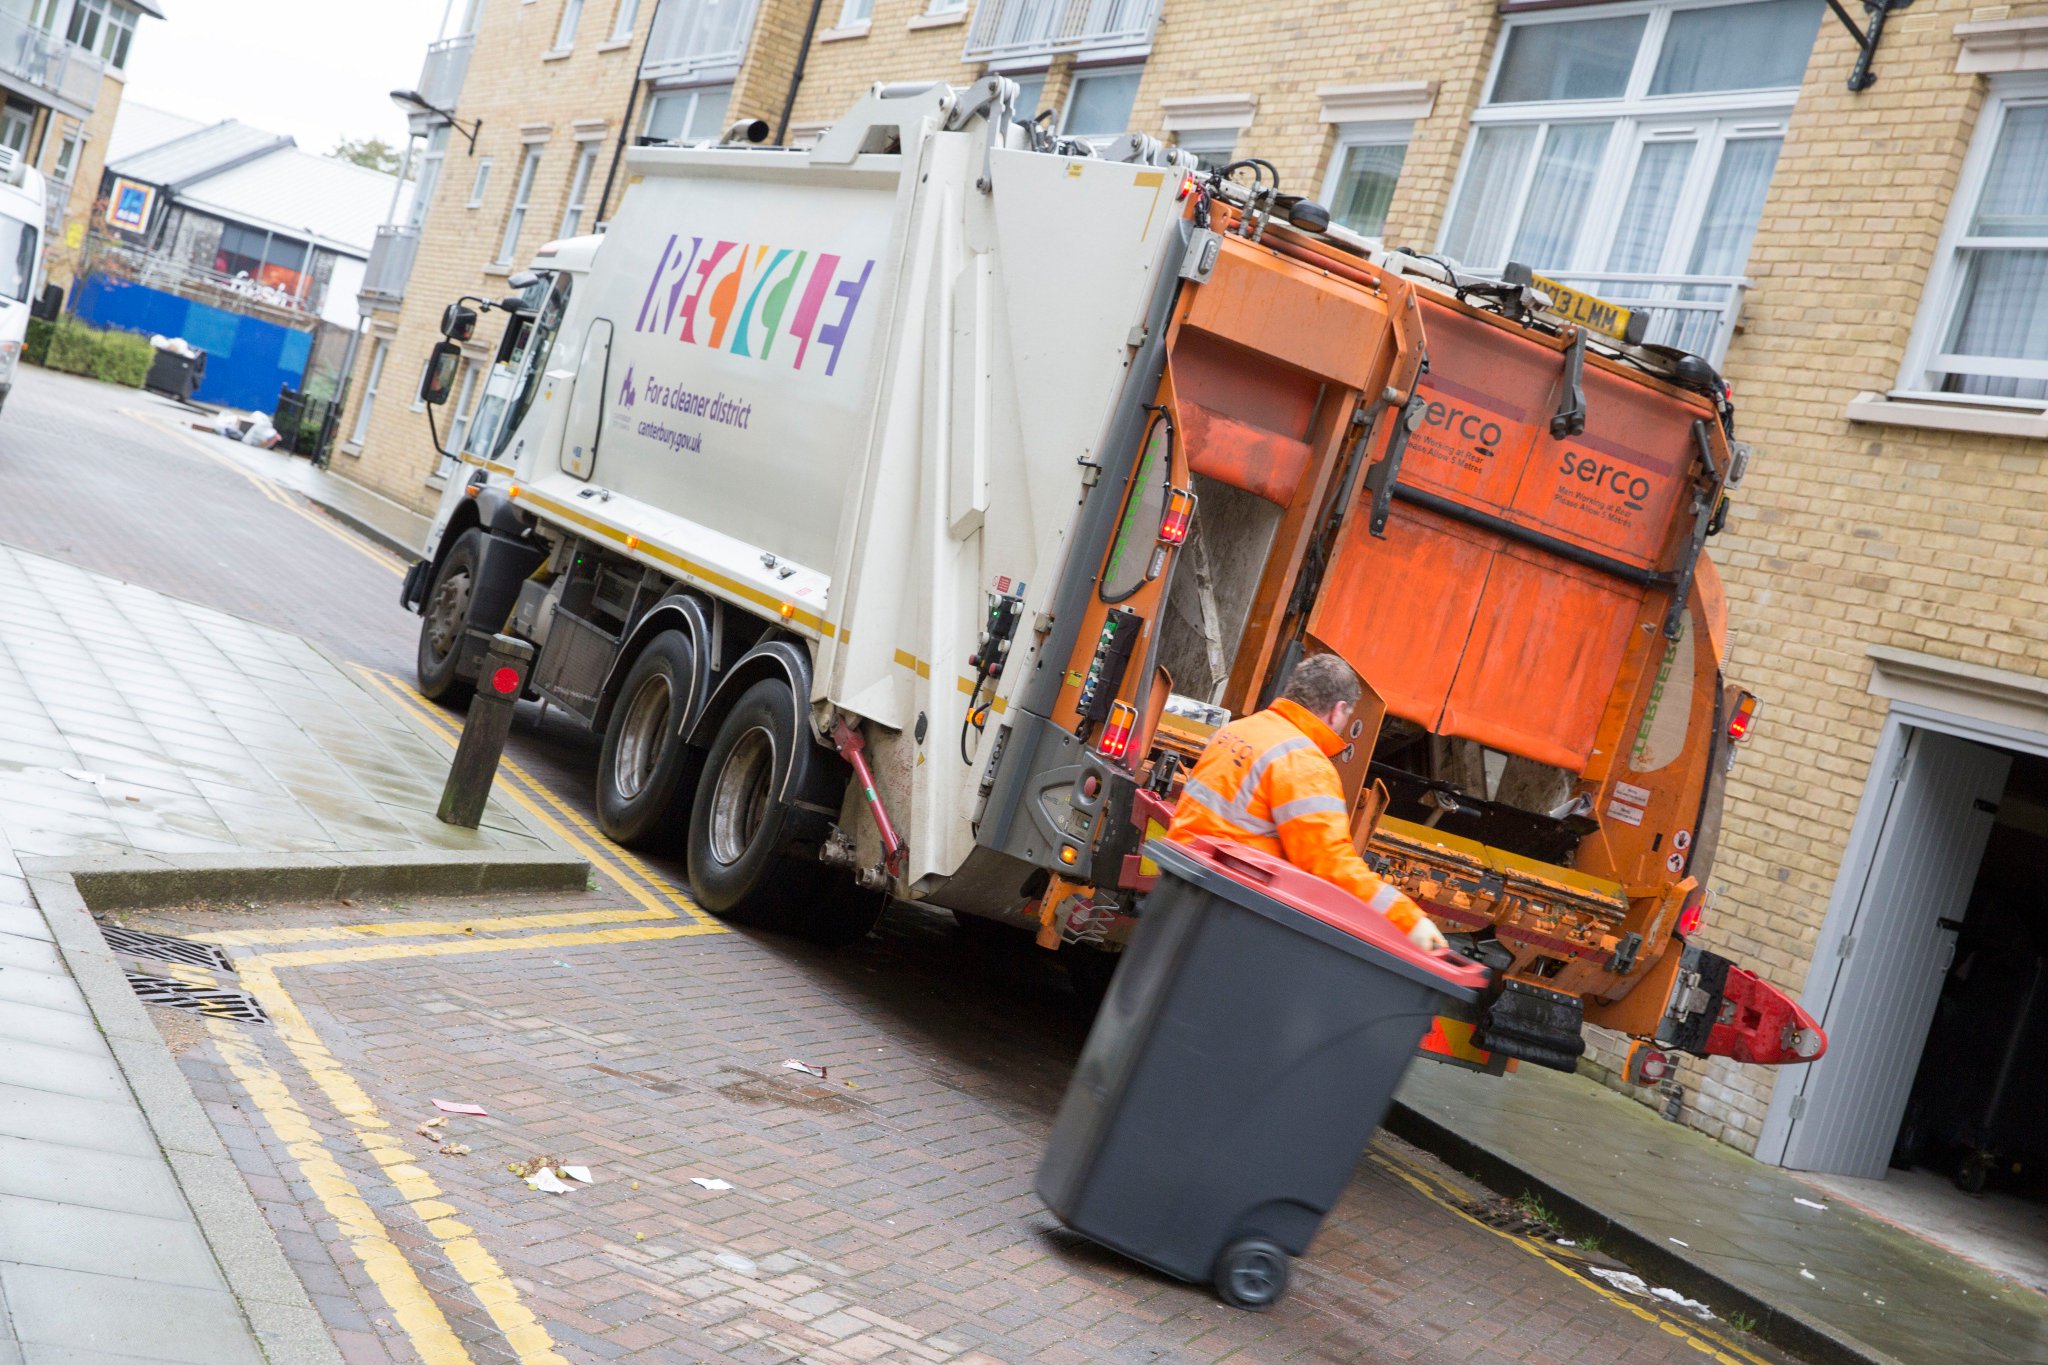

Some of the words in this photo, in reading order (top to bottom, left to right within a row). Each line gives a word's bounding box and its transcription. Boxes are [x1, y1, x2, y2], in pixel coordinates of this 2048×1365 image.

[635, 234, 876, 377] RECYCLE
[1574, 297, 1619, 333] LMM
[644, 376, 665, 404] For
[663, 386, 671, 406] a
[670, 381, 711, 418] cleaner
[709, 391, 752, 430] district
[637, 419, 703, 454] canterbury.gov.uk
[1424, 400, 1502, 447] erco
[1407, 441, 1427, 453] ease
[1427, 447, 1449, 461] Allow
[1451, 456, 1457, 464] 5
[1457, 457, 1484, 475] Metres
[1423, 435, 1455, 456] Working
[1456, 449, 1465, 457] at
[1465, 451, 1484, 465] Rear
[1559, 450, 1650, 501] serco
[1554, 493, 1579, 509] Please
[1579, 503, 1600, 516] Allow
[1601, 511, 1607, 519] 5
[1607, 512, 1632, 528] Metres
[1558, 485, 1574, 497] Men
[1575, 489, 1606, 511] Working
[1606, 503, 1615, 512] at
[1614, 505, 1633, 519] Rear
